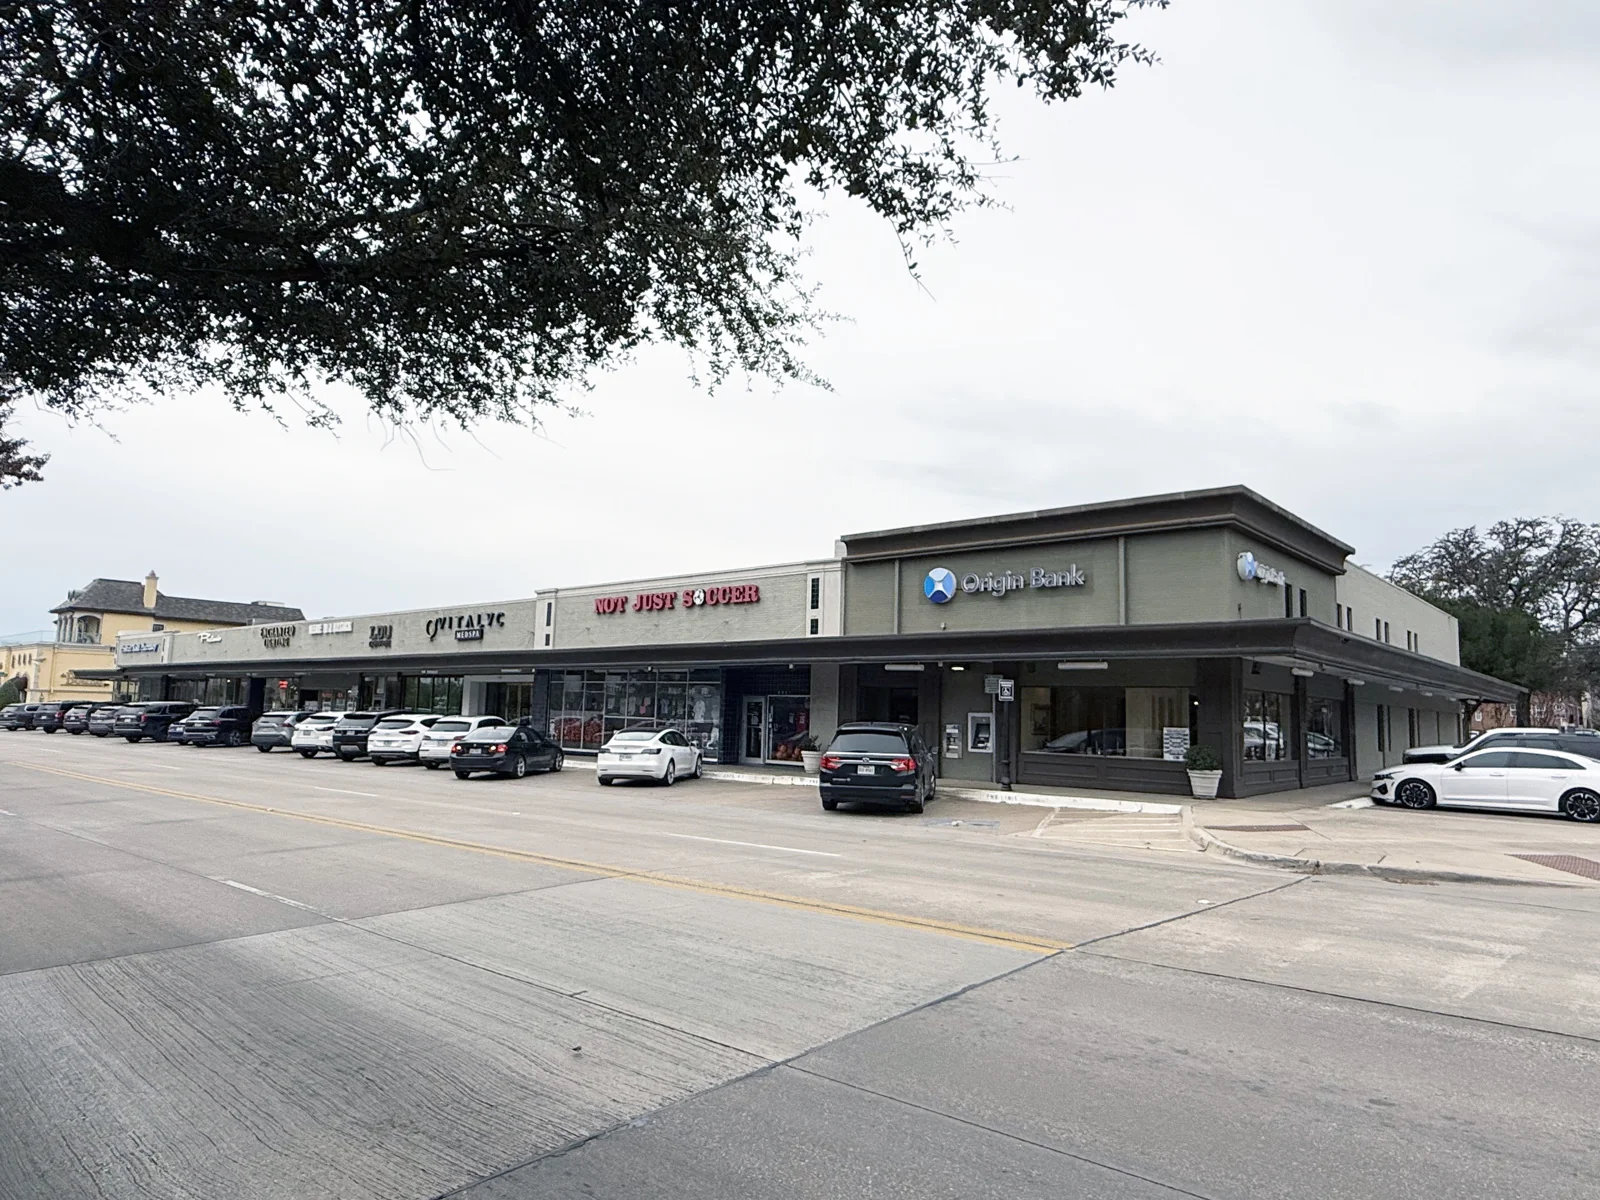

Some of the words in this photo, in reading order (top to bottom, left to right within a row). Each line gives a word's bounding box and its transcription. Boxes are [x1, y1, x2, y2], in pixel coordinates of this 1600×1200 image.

[961, 570, 1025, 597] Origin
[1030, 564, 1085, 588] Bank
[595, 596, 628, 614] NOT
[632, 591, 677, 611] JUST
[682, 584, 760, 607] SOCCER
[456, 630, 481, 639] MEDSPA
